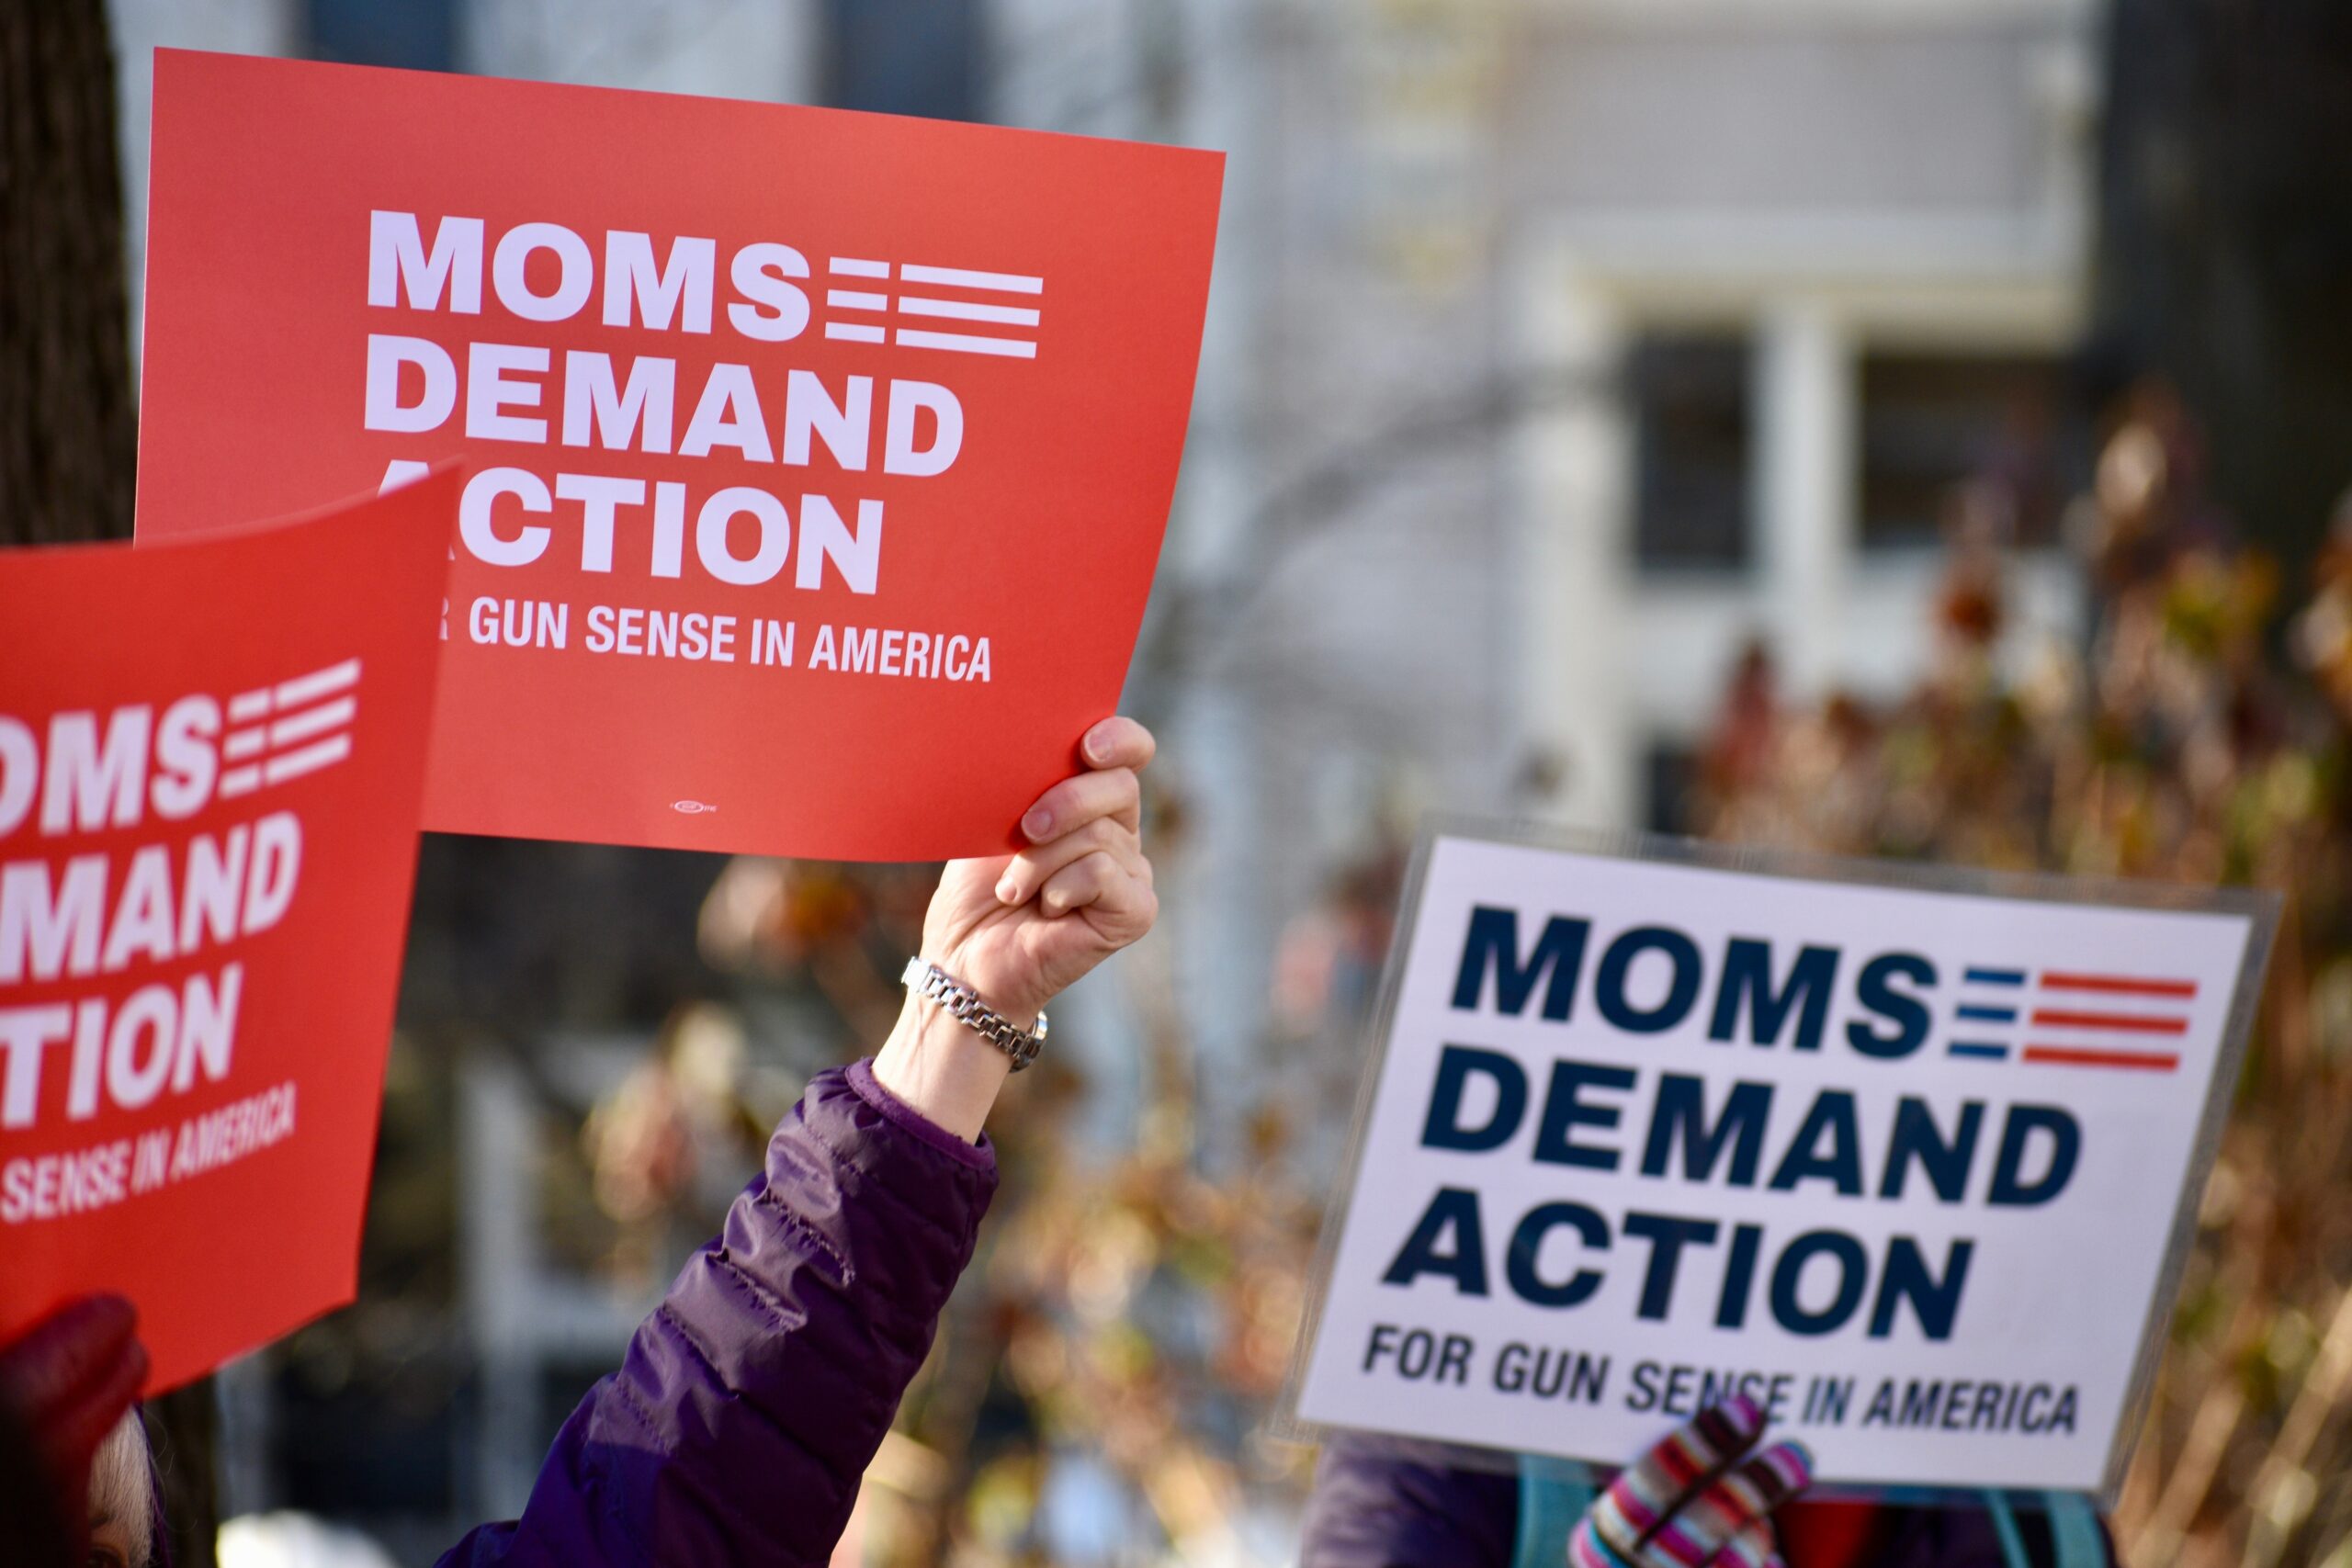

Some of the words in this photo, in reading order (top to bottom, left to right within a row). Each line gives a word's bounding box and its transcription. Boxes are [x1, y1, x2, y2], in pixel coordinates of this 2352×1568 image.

[368, 209, 810, 342] MOMS
[364, 333, 964, 477] DEMAND
[377, 459, 884, 595] CTION
[469, 596, 568, 649] GUN
[585, 605, 737, 662] SENSE
[749, 618, 796, 668] IN
[808, 624, 991, 682] AMERICA
[1450, 904, 1940, 1062] MOMS
[0, 1140, 130, 1223] SENSE
[130, 1127, 171, 1193] IN
[169, 1080, 296, 1181] AMERICA
[1419, 1043, 2084, 1210] DEMAND
[1381, 1185, 1975, 1343] ACTION
[1363, 1325, 1476, 1385] FOR
[1493, 1342, 1611, 1405] GUN
[1802, 1374, 1855, 1427] IN
[1861, 1379, 2078, 1435] AMERICA
